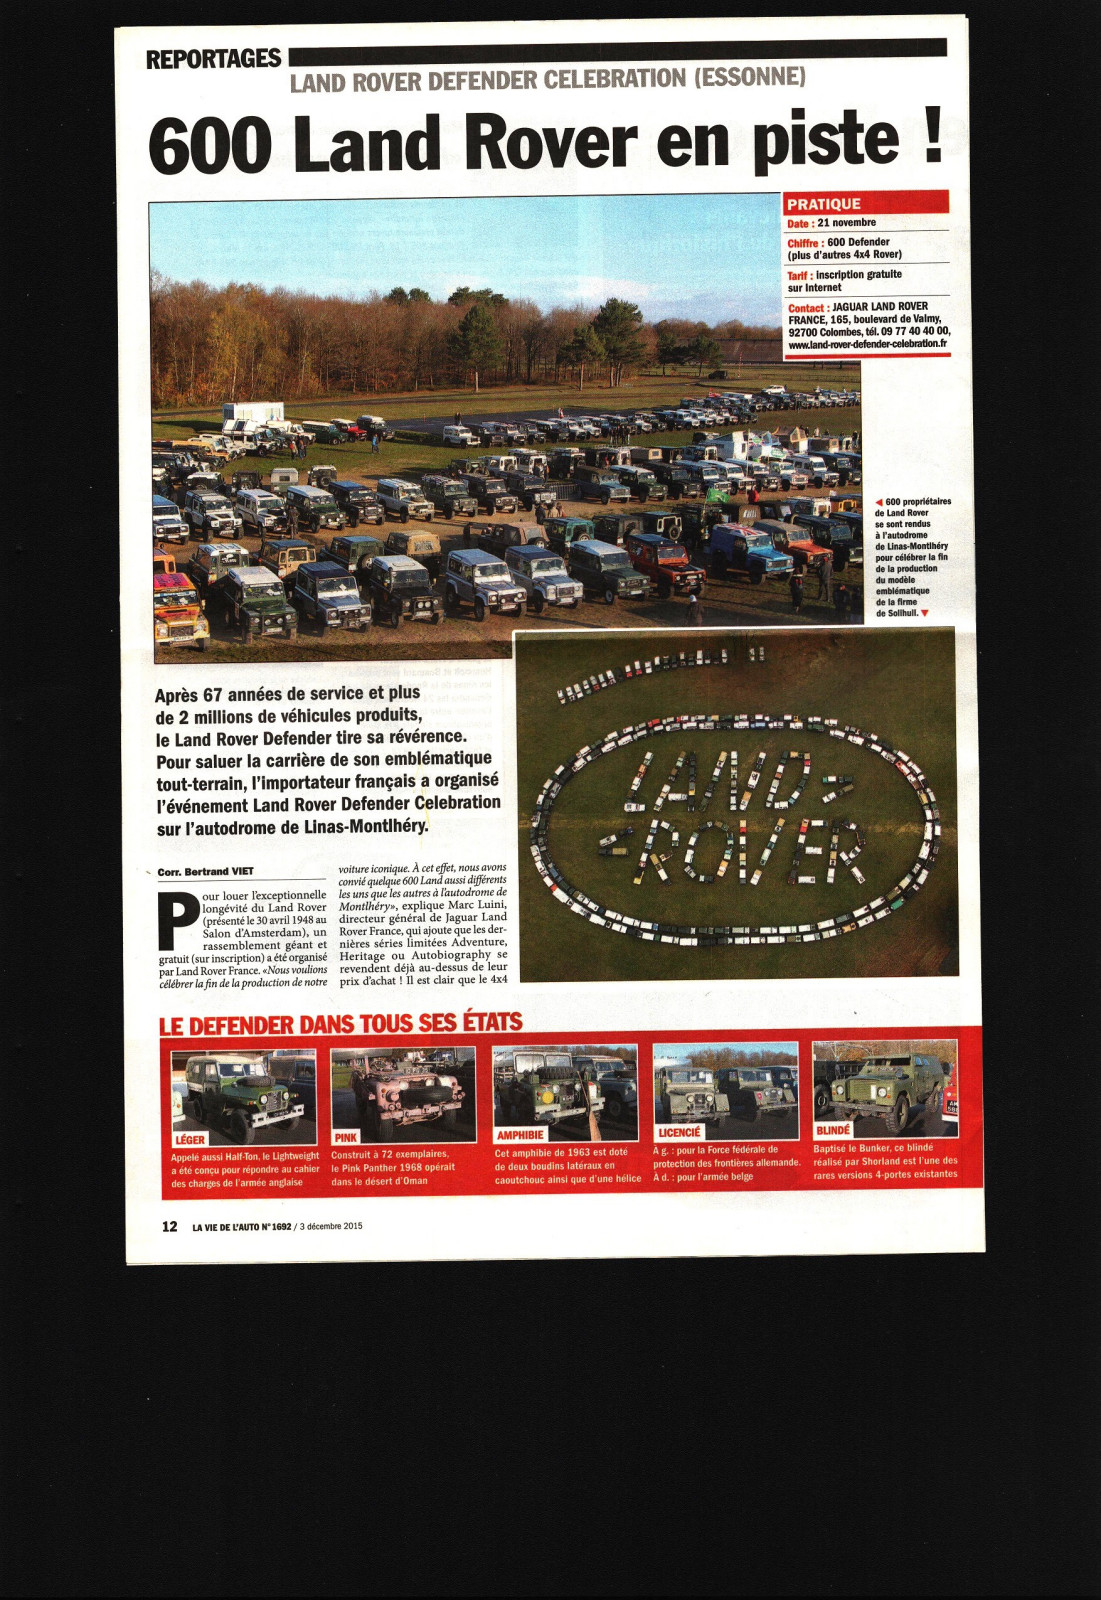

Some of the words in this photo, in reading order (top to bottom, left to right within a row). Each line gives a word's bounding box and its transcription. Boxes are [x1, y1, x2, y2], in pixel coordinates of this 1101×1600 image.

[146, 47, 282, 70] REPORTAGES
[290, 73, 346, 94] LAND
[353, 72, 422, 92] ROVER
[428, 70, 538, 91] DEFENDER
[544, 68, 686, 89] CELEBRATION
[694, 66, 806, 89] (ESSONNE)
[149, 116, 272, 176] 600
[294, 113, 440, 173] Land
[466, 112, 638, 170] Rover
[657, 124, 729, 168] en
[754, 107, 900, 177] piste
[788, 198, 861, 212] PRATIQUE
[787, 219, 810, 229] Date
[818, 218, 830, 227] 21
[832, 217, 876, 227] novembre
[787, 238, 819, 248] Chiffre
[827, 237, 846, 247] 600
[848, 237, 890, 247] Defender
[788, 304, 825, 313] Contact
[832, 302, 868, 312] JAGUAR
[871, 301, 896, 311] LAND
[898, 301, 928, 311] ROVER
[788, 315, 828, 326] FRANCE,
[830, 314, 852, 325] 165,
[854, 314, 898, 324] boulevard
[900, 314, 912, 323] de
[913, 313, 942, 325] Valmy,
[788, 327, 818, 338] 92700
[820, 327, 864, 338] Colombes,
[865, 326, 880, 336] tél.
[881, 326, 893, 336] 09
[895, 326, 906, 336] 77
[908, 326, 921, 336] 40
[922, 326, 935, 335] 40
[936, 326, 951, 336] 00,
[788, 338, 948, 350] www.land-rover-defender-celebration.fr
[885, 498, 901, 506] 600
[903, 497, 952, 507] propriétaires
[875, 531, 880, 539] à
[882, 531, 928, 540] l'autodrome
[875, 542, 885, 551] de
[887, 541, 949, 551] Linas-Montlhéry
[875, 555, 893, 563] pour
[894, 552, 927, 562] célébrer
[928, 553, 936, 561] la
[938, 552, 948, 561] fin
[876, 586, 930, 596] emblématique
[876, 609, 886, 618] de
[888, 609, 919, 617] Solihull.
[155, 687, 198, 706] Après
[203, 687, 222, 702] 67
[228, 686, 282, 702] années
[287, 686, 305, 701] de
[310, 685, 364, 700] service
[369, 685, 384, 700] et
[389, 684, 420, 702] plus
[156, 776, 247, 793] tout-terrain,
[252, 775, 351, 793] l'importateur
[355, 773, 416, 792] français
[421, 776, 430, 788] a
[435, 771, 499, 790] organisé
[157, 798, 248, 814] l'événement
[253, 797, 289, 812] Land
[294, 797, 337, 812] Rover
[342, 796, 410, 811] Defender
[414, 794, 501, 810] Celebration
[157, 868, 182, 876] Corr.
[184, 867, 229, 876] Bertrand
[232, 866, 254, 876] VIET
[223, 891, 249, 901] louer
[252, 889, 327, 903] l'exceptionnelle
[339, 901, 398, 913] Montlhéry»,
[402, 900, 444, 913] explique
[448, 900, 474, 910] Marc
[478, 899, 507, 910] Luini,
[203, 916, 245, 928] (présenté
[246, 916, 255, 925] le
[256, 916, 268, 925] 30
[269, 915, 290, 925] avril
[293, 915, 314, 925] 1948
[339, 914, 386, 924] directeur
[389, 912, 426, 926] général
[429, 912, 442, 922] de
[445, 913, 478, 925] Jaguar
[482, 911, 508, 921] Land
[203, 928, 231, 938] Salon
[235, 927, 310, 938] d'Amsterdam),
[313, 929, 327, 937] un
[203, 940, 281, 951] rassemblement
[285, 940, 313, 953] géant
[317, 941, 327, 949] et
[339, 939, 370, 949] nières
[374, 938, 403, 948] séries
[407, 938, 447, 948] limitées
[451, 937, 508, 947] Adventure,
[159, 1017, 184, 1036] LE
[190, 1015, 294, 1036] DEFENDER
[300, 1014, 355, 1034] DANS
[359, 1013, 414, 1033] TOUS
[418, 1012, 457, 1032] SES
[463, 1007, 523, 1032] ÉTATS
[497, 1130, 544, 1140] AMPHIBIE
[658, 1125, 701, 1138] LICENCIÉ
[816, 1123, 850, 1136] BLINDÉ
[176, 1133, 205, 1145] LÉGER
[335, 1133, 357, 1143] PINK
[171, 1153, 199, 1163] Appelé
[201, 1152, 223, 1162] aussi
[225, 1152, 260, 1161] Half-Ton,
[262, 1152, 270, 1160] le
[272, 1151, 320, 1162] Lightweight
[331, 1164, 339, 1173] le
[342, 1164, 360, 1172] Pink
[363, 1163, 397, 1172] Panther
[400, 1162, 422, 1172] 1968
[424, 1162, 455, 1173] opérait
[653, 1159, 695, 1170] protection
[697, 1159, 712, 1168] des
[714, 1158, 754, 1168] frontières
[756, 1158, 801, 1167] allemande.
[495, 1175, 545, 1184] caoutchouc
[547, 1175, 568, 1184] ainsi
[570, 1176, 587, 1185] que
[589, 1174, 613, 1183] d'une
[616, 1174, 642, 1183] hélice
[837, 1171, 873, 1180] versions
[875, 1170, 912, 1181] 4-portes
[914, 1169, 958, 1178] existantes
[162, 1220, 178, 1232] 12
[192, 1224, 203, 1232] LA
[204, 1224, 218, 1232] VIE
[220, 1223, 230, 1232] DE
[232, 1223, 260, 1232] L'AUTO
[300, 1222, 305, 1230] 3
[307, 1222, 342, 1230] décembre
[344, 1222, 363, 1230] 2015
